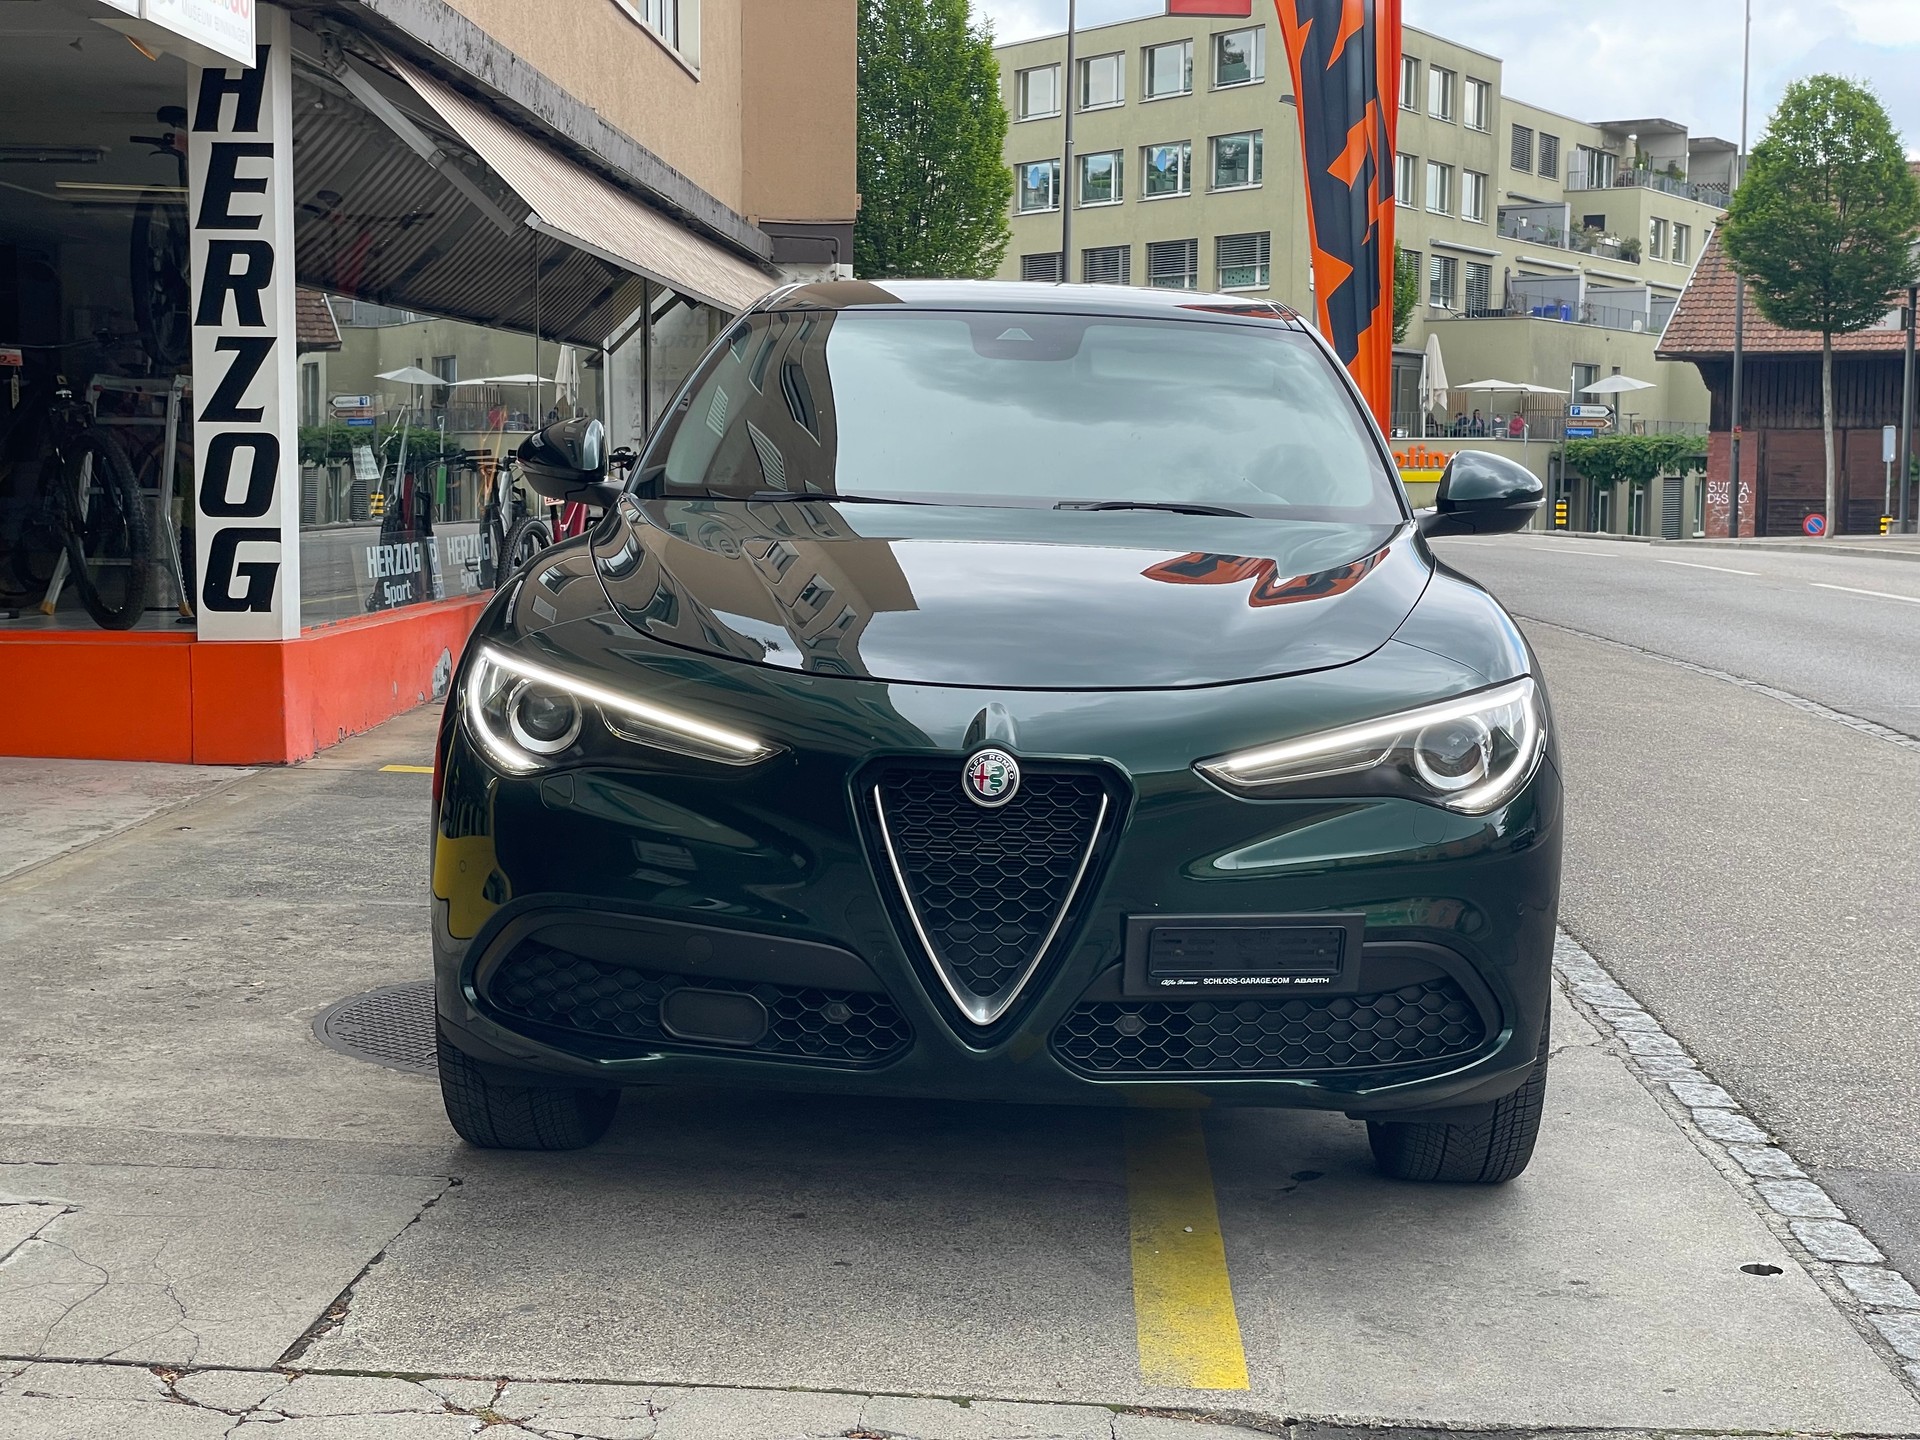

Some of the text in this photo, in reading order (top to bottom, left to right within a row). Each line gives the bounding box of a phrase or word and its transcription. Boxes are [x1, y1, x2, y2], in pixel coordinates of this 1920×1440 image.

[193, 45, 282, 612] HERZOG
[366, 541, 421, 579] HERZOG
[383, 580, 413, 608] Sport
[968, 754, 1015, 780] ALFA ROMEO
[1203, 977, 1290, 985] SCHLOSS-GARAGE.COM
